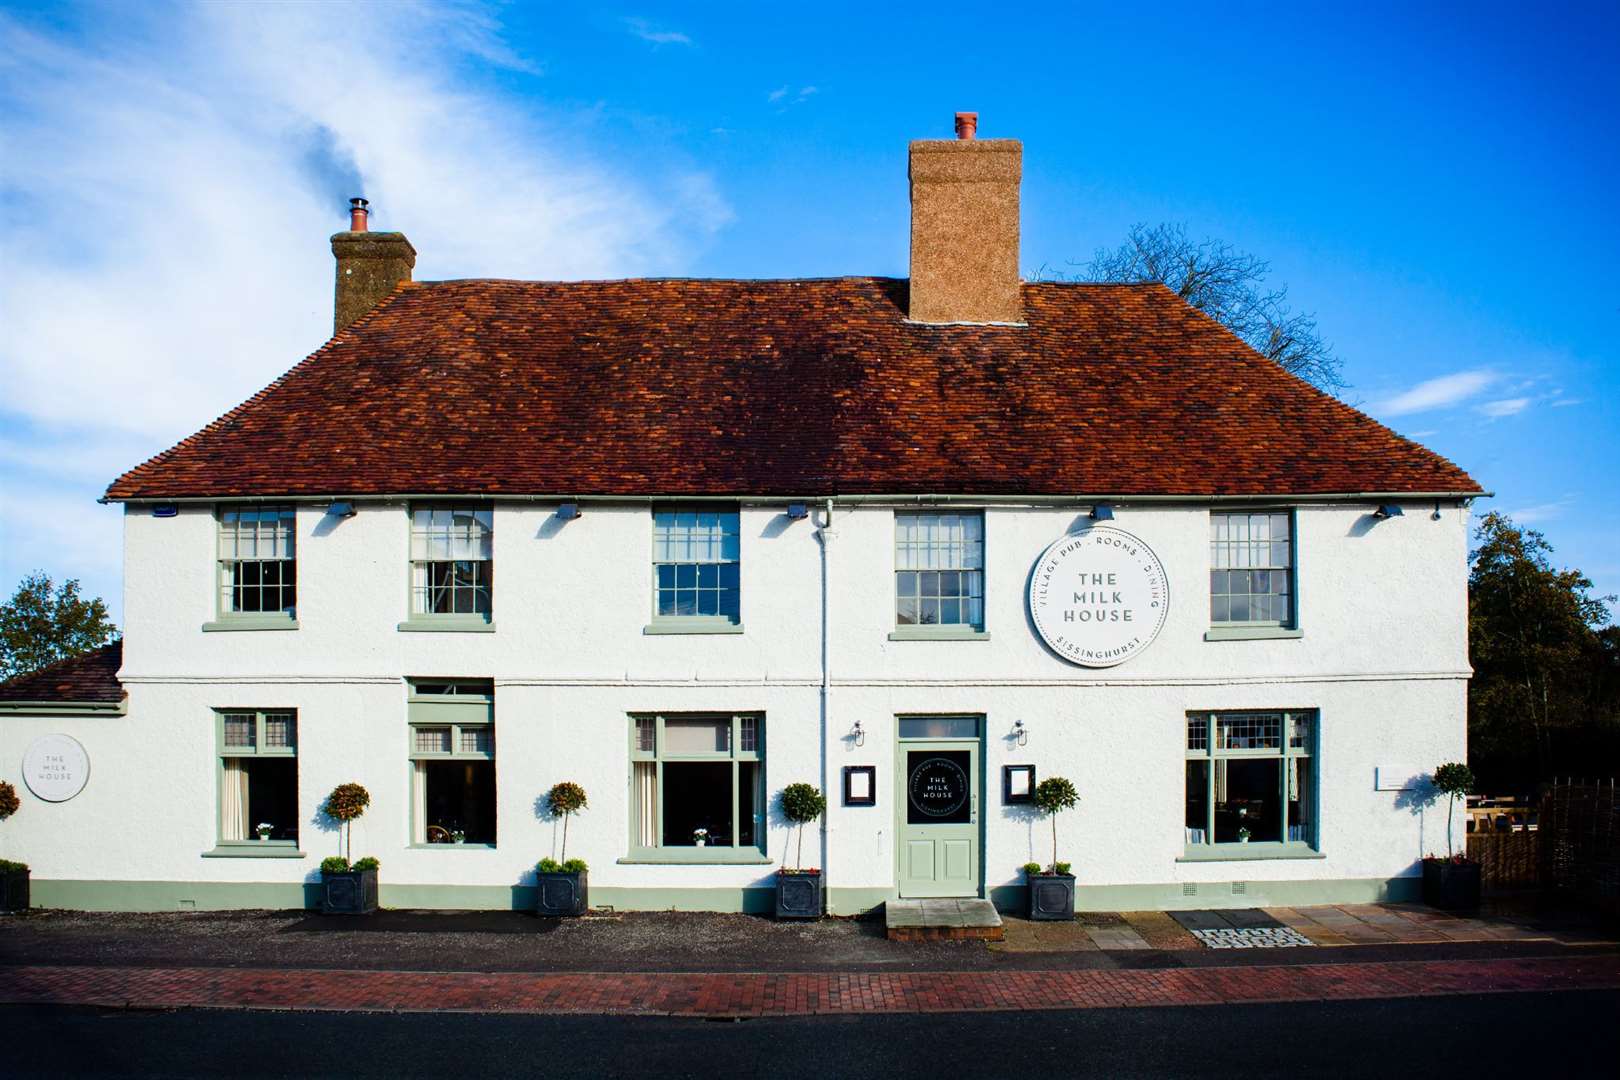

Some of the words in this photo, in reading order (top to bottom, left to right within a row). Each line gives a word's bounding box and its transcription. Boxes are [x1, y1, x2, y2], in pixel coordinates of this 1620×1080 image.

[1039, 559, 1059, 608] VILLAGE
[1060, 540, 1082, 557] PUB
[1096, 537, 1137, 556] ROOMS
[1143, 565, 1159, 608] DINING
[1078, 573, 1117, 585] THE
[1073, 591, 1122, 604] MILK
[1064, 609, 1133, 622] HOUSE
[1056, 636, 1141, 659] SISSINGHURST
